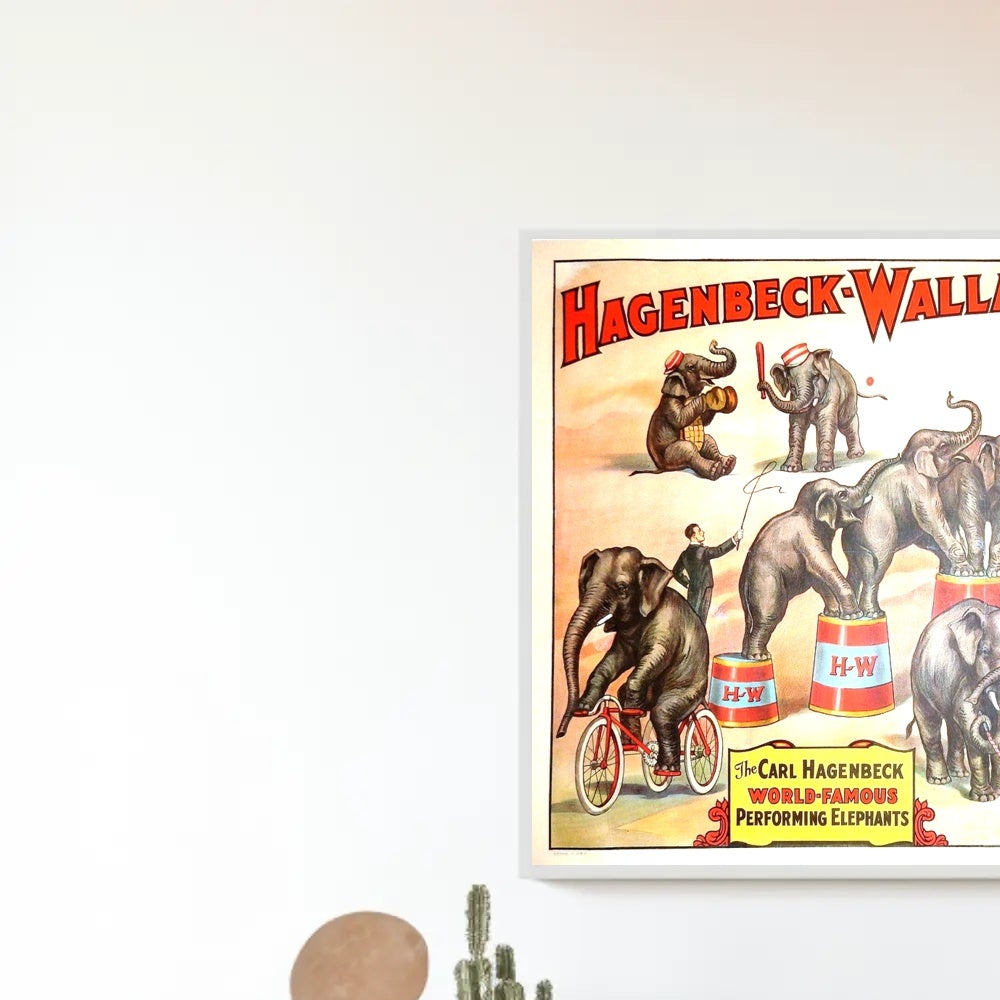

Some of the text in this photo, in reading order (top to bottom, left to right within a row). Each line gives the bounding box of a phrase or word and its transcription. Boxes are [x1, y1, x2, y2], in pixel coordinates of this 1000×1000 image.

[829, 655, 878, 677] H-W
[722, 686, 765, 702] H-W
[734, 758, 904, 780] The CARL HAGENBECK
[748, 787, 898, 805] WORLD-FAMOUS
[736, 807, 909, 827] PERFORMING ELEPHANTS
